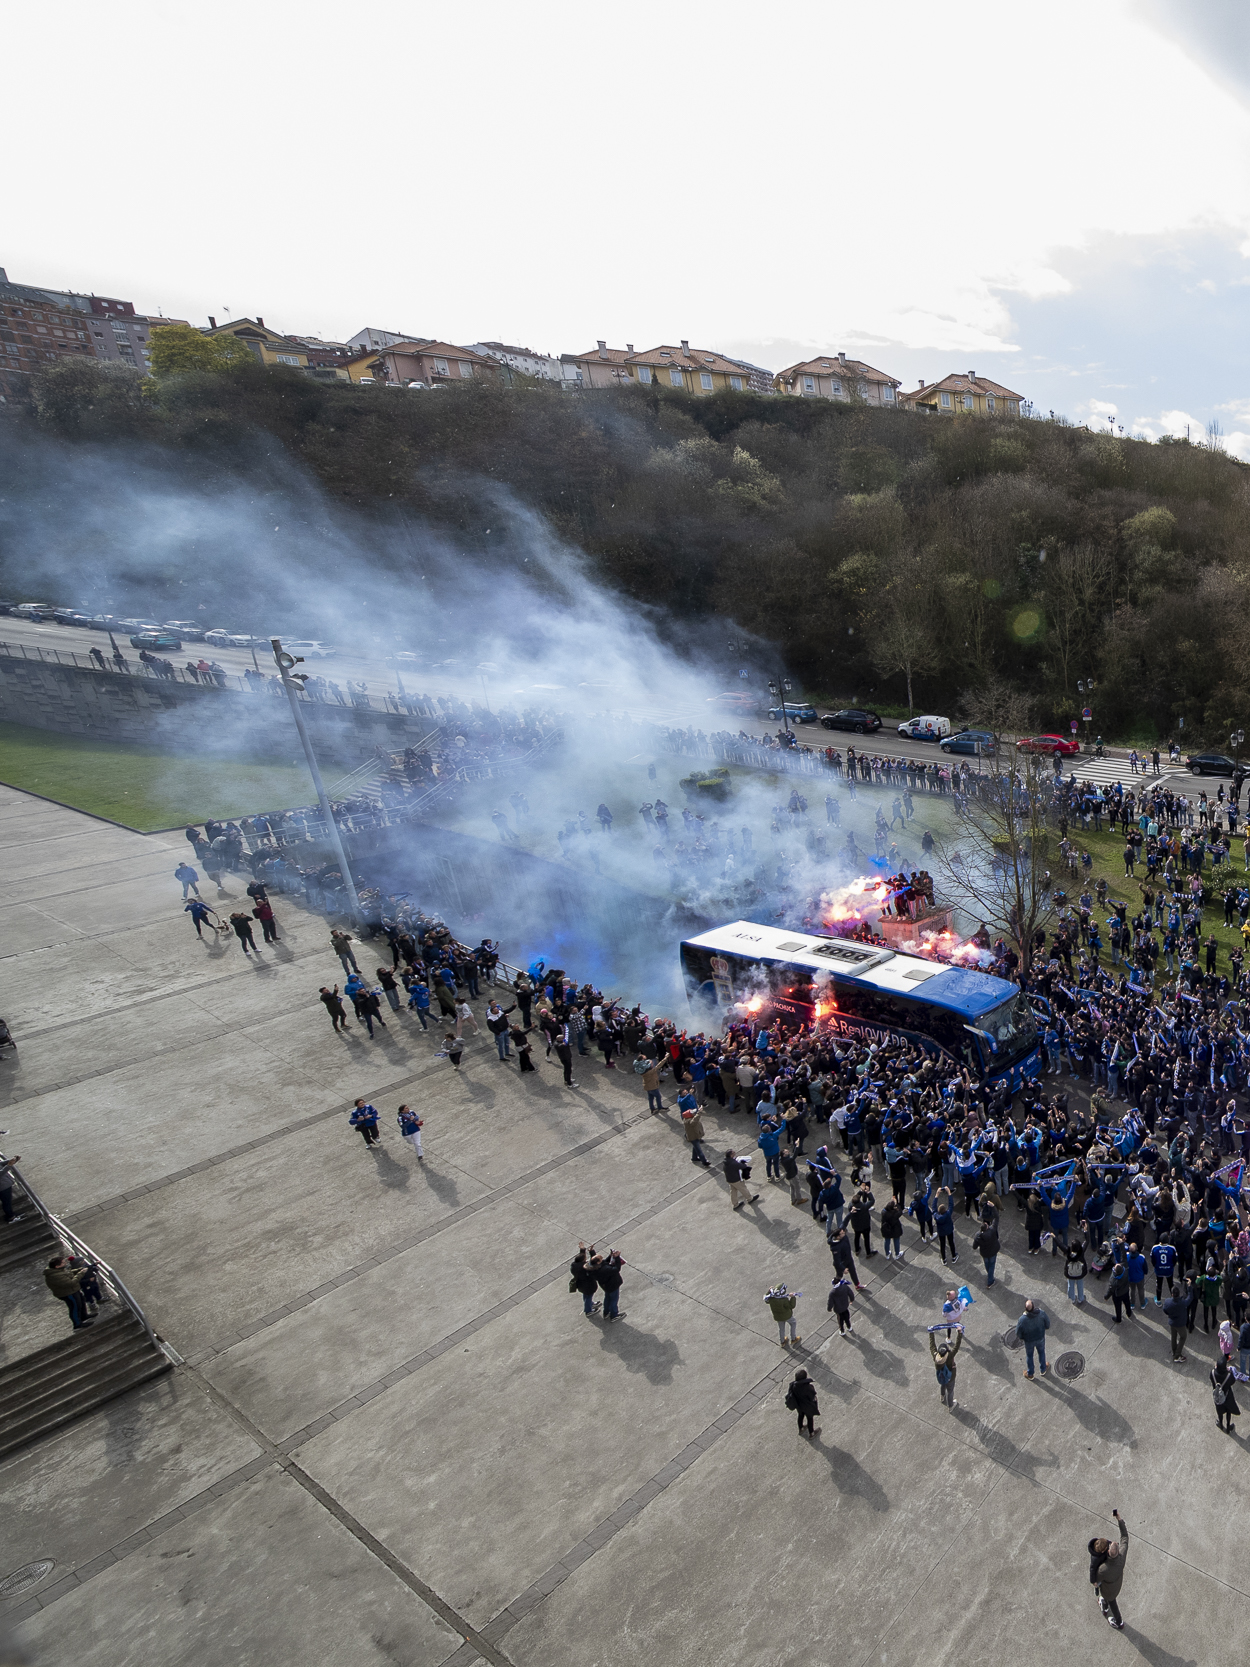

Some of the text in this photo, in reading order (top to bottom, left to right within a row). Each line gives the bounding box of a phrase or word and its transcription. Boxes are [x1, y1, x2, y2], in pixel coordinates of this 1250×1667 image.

[731, 933, 763, 943] ALSA
[773, 1002, 796, 1014] PACHUCA
[1160, 1253, 1167, 1265] 9
